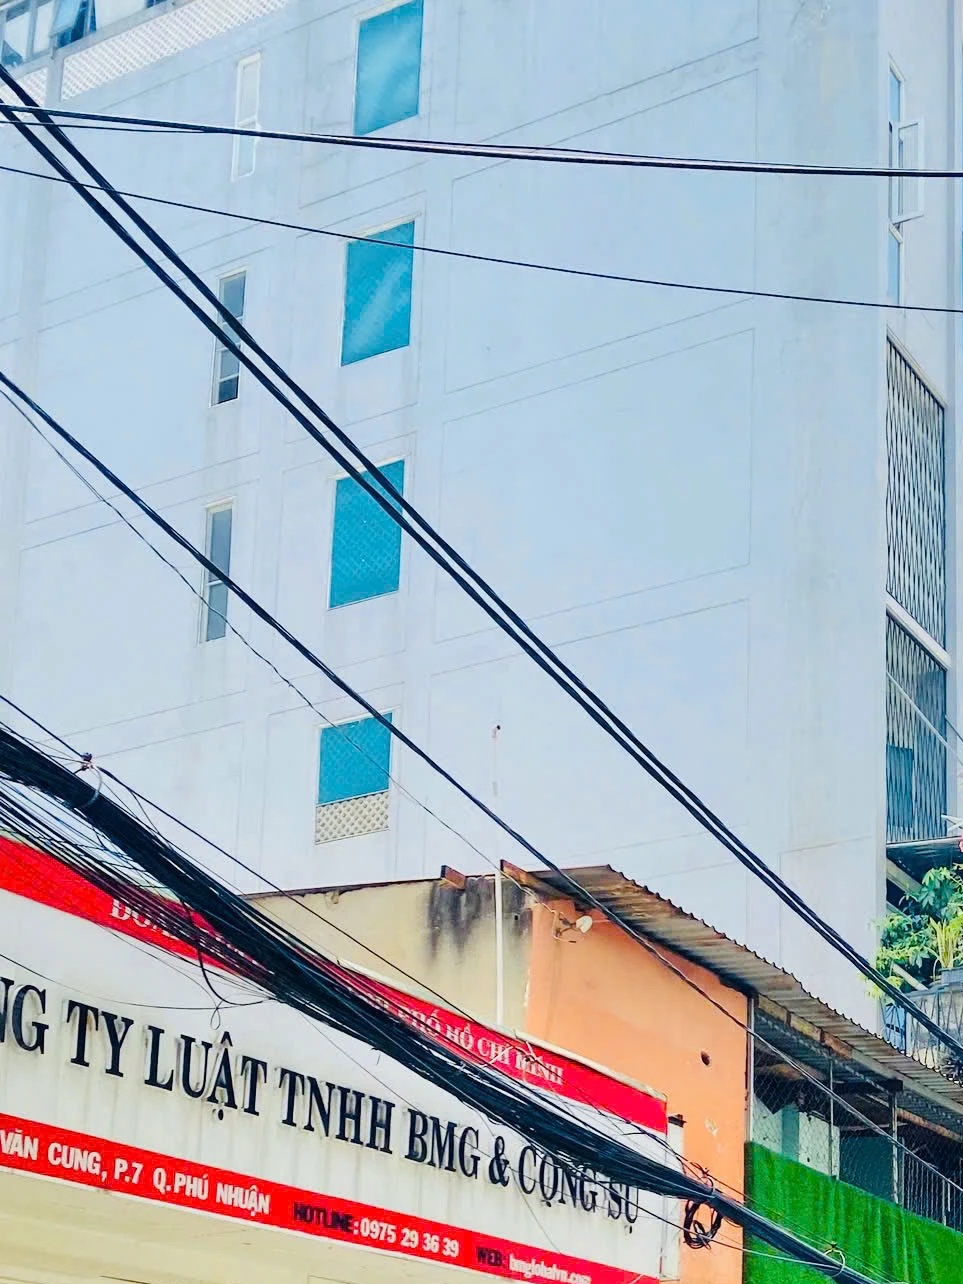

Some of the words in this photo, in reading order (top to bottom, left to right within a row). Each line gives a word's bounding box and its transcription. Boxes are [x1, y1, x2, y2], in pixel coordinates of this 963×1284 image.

[67, 1000, 134, 1078] TY
[145, 1025, 268, 1121] LUẬT
[279, 1067, 396, 1155] TNHH
[404, 1108, 480, 1180] BMG
[489, 1135, 510, 1188] &
[0, 1129, 38, 1161] VĂN
[48, 1142, 108, 1183] CUNG,
[114, 1158, 144, 1184] P.7
[216, 1182, 271, 1217] NHUẬN
[400, 1227, 419, 1249] 29
[422, 1233, 440, 1253] 36
[442, 1238, 460, 1258] 39
